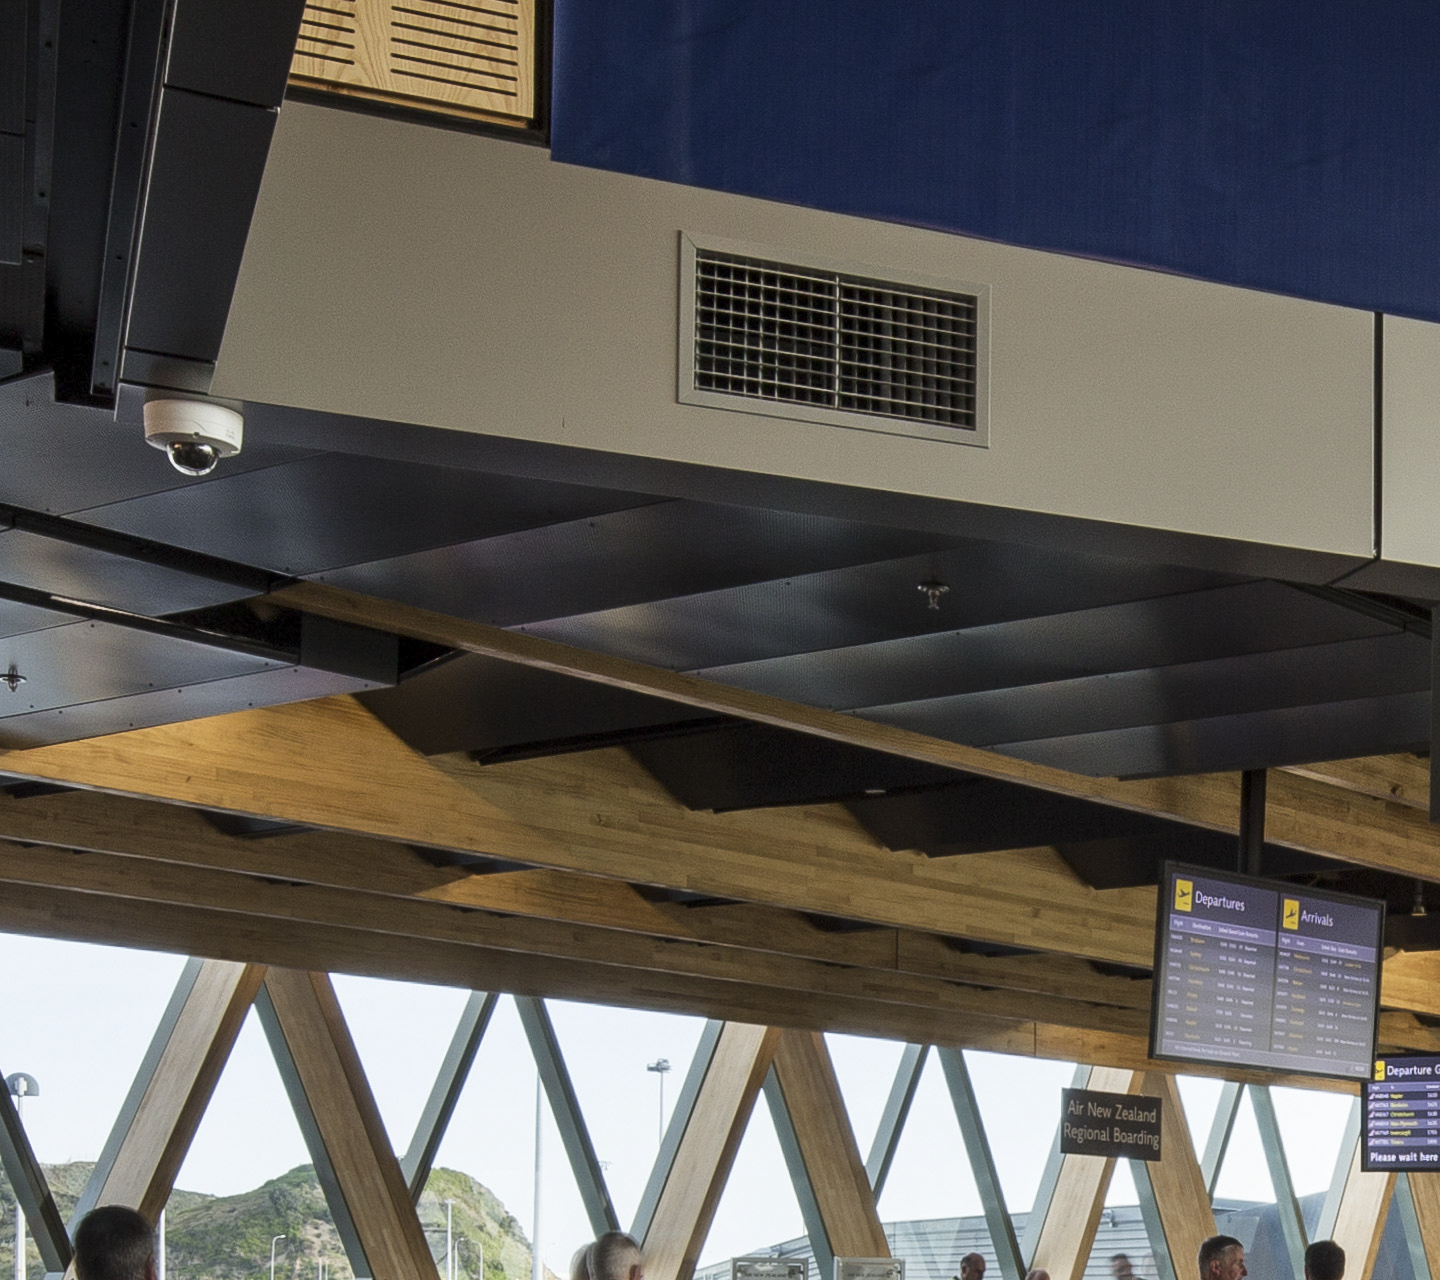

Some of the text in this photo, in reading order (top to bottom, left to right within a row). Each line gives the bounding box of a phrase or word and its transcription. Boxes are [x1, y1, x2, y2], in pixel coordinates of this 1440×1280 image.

[1195, 890, 1245, 912] Departures
[1301, 910, 1334, 927] Arrivals
[1387, 1064, 1432, 1076] Departure
[1067, 1099, 1157, 1123] Air New Zealand
[1063, 1122, 1160, 1151] Regional Boarding
[1370, 1151, 1397, 1163] Please
[1398, 1151, 1418, 1162] wait
[1420, 1151, 1439, 1162] here
